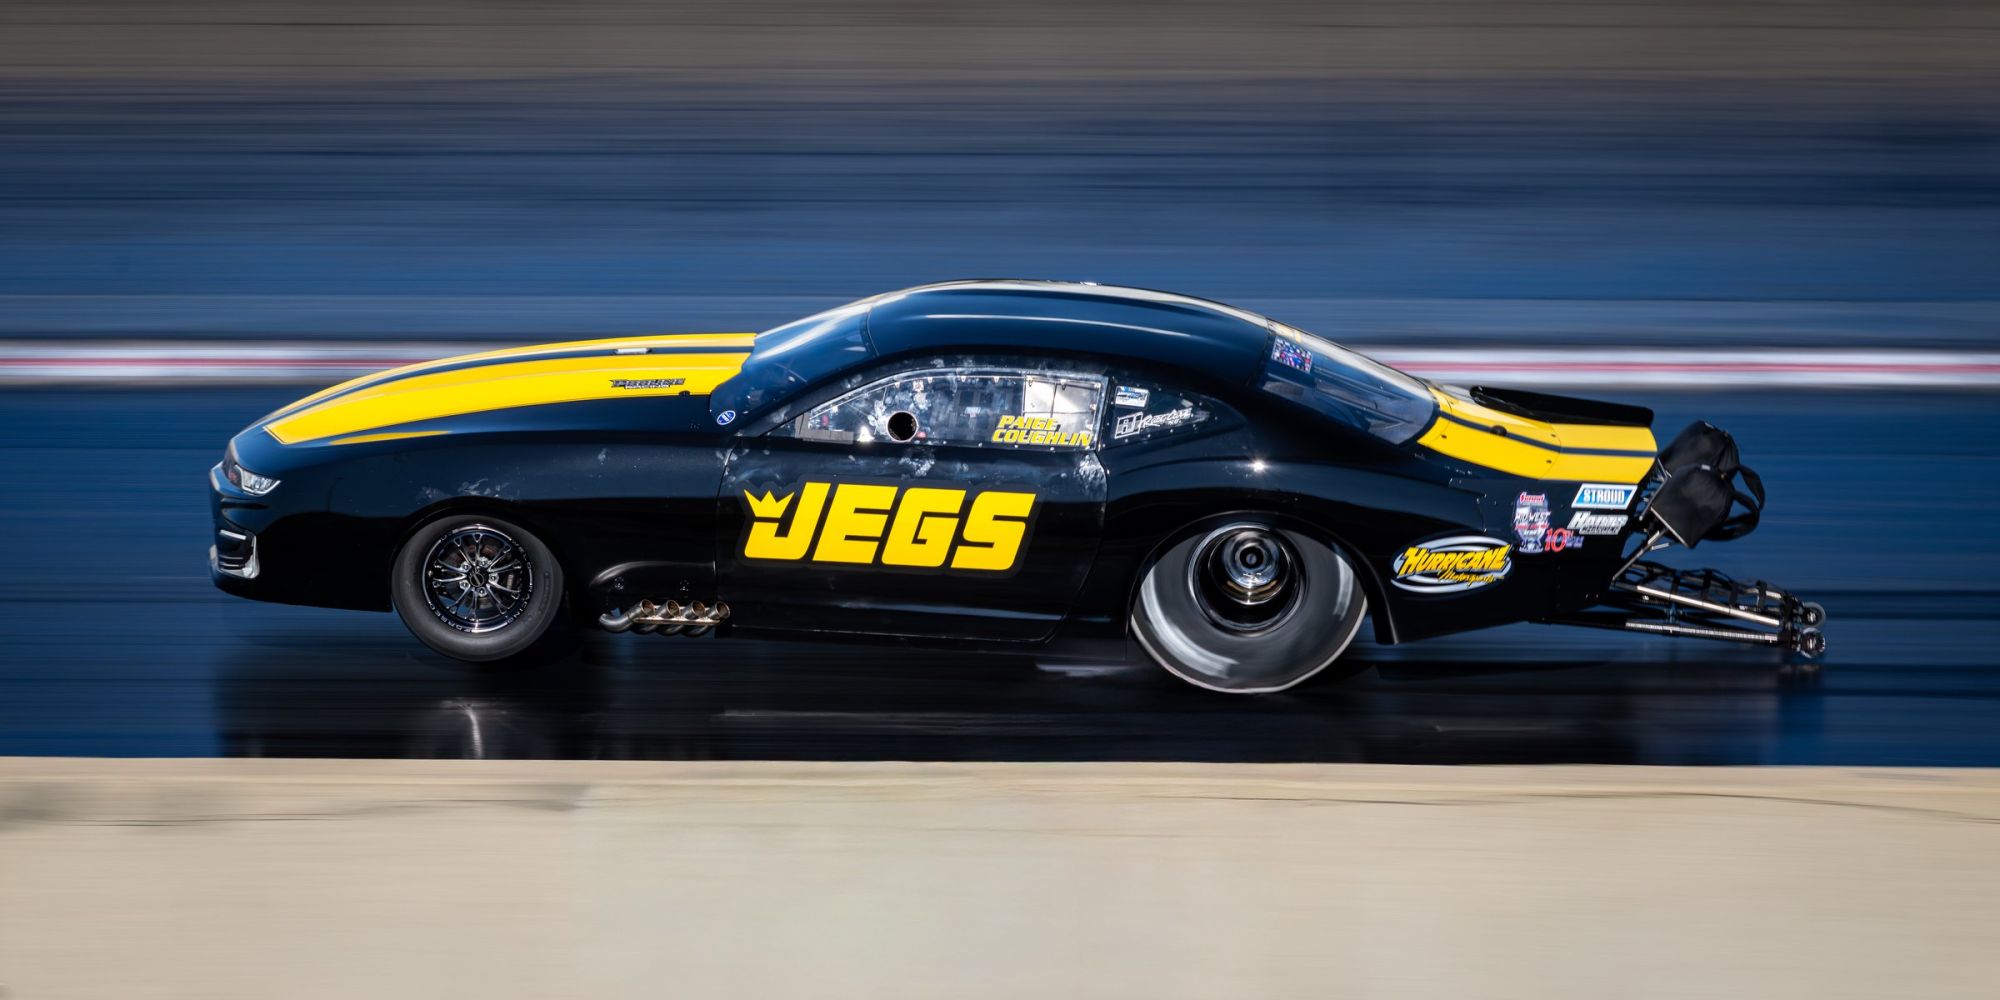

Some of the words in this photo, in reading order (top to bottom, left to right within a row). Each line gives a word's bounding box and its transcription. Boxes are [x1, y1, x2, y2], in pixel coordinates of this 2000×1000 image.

[997, 415, 1058, 431] PAIGE
[992, 429, 1092, 447] COUGHLIN
[1583, 489, 1625, 505] STROUD
[744, 481, 1037, 571] JEGS
[1397, 543, 1512, 578] HURRICANE
